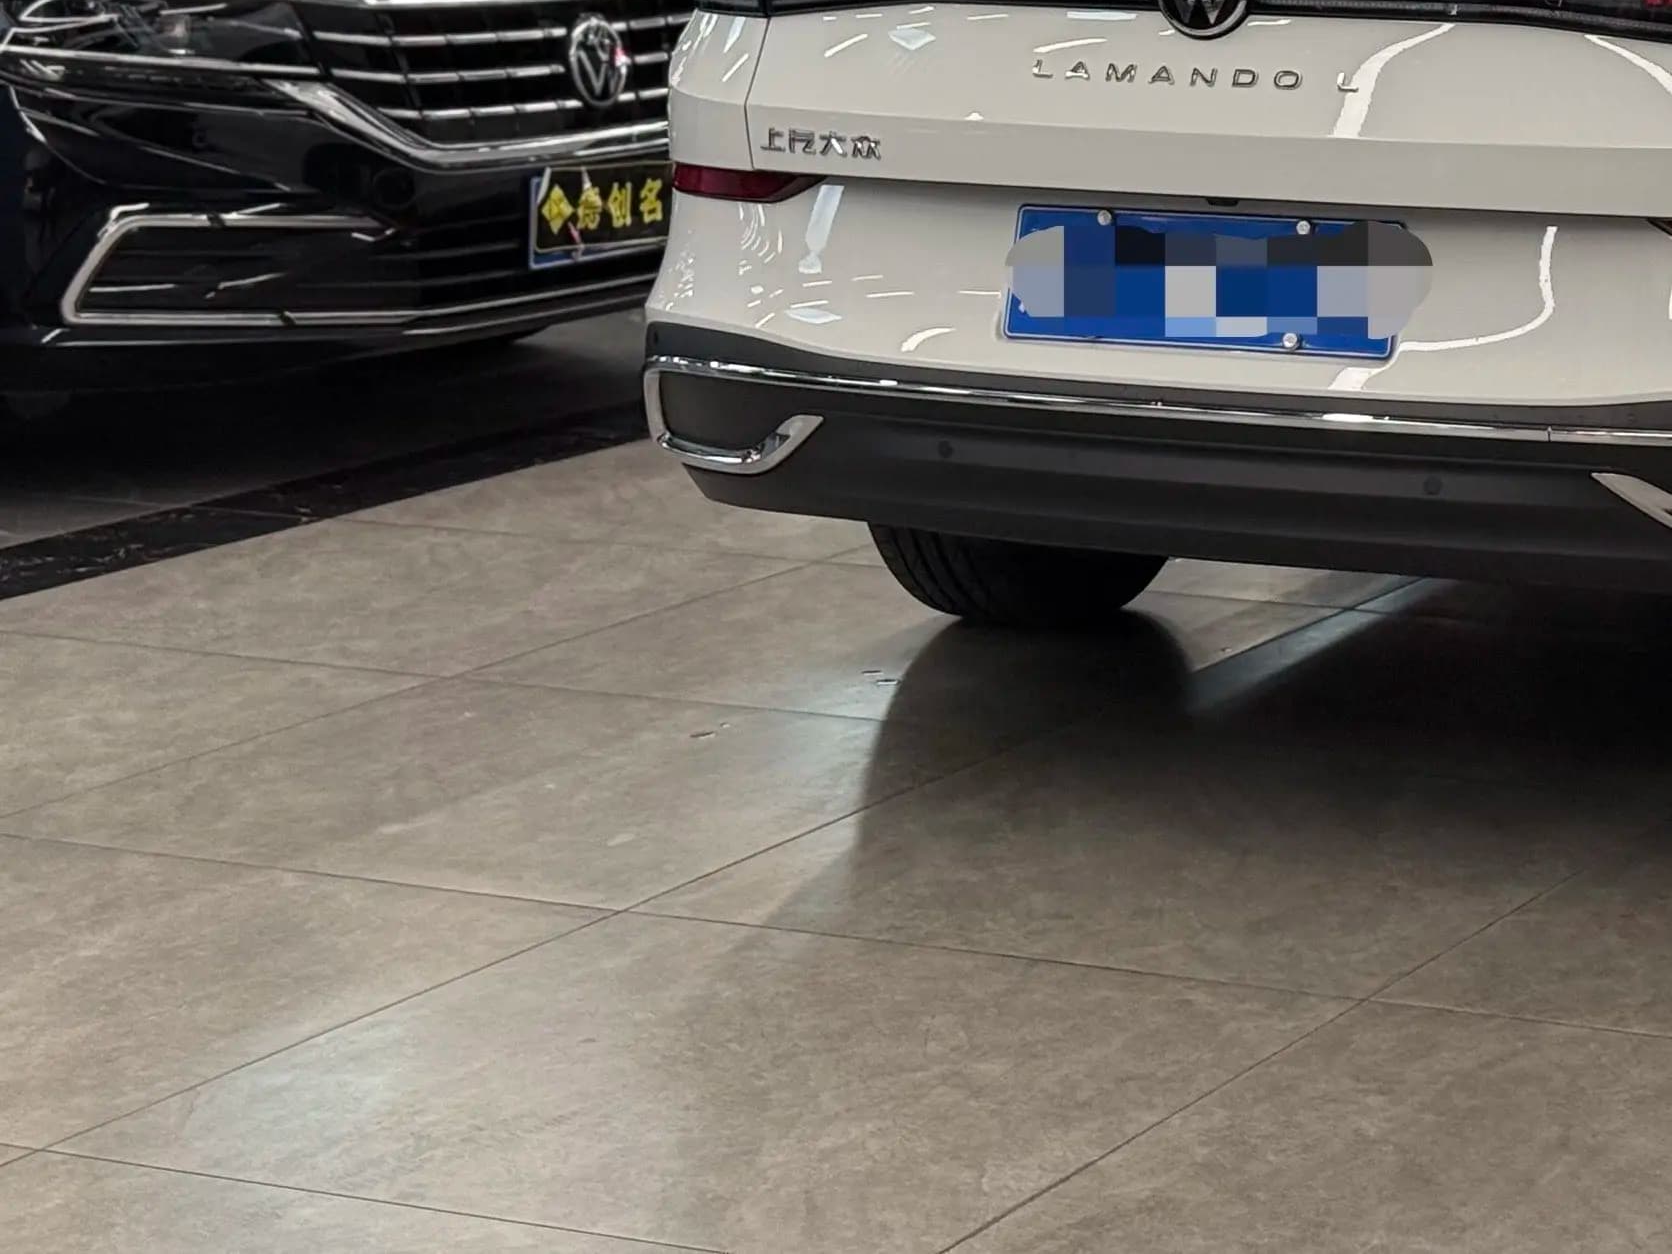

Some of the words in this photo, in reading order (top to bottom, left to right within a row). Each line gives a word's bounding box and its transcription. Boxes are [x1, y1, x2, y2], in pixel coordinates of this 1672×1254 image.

[1031, 58, 1304, 91] LAMANDO
[1336, 71, 1359, 92] L
[759, 126, 883, 161] 上汽大众
